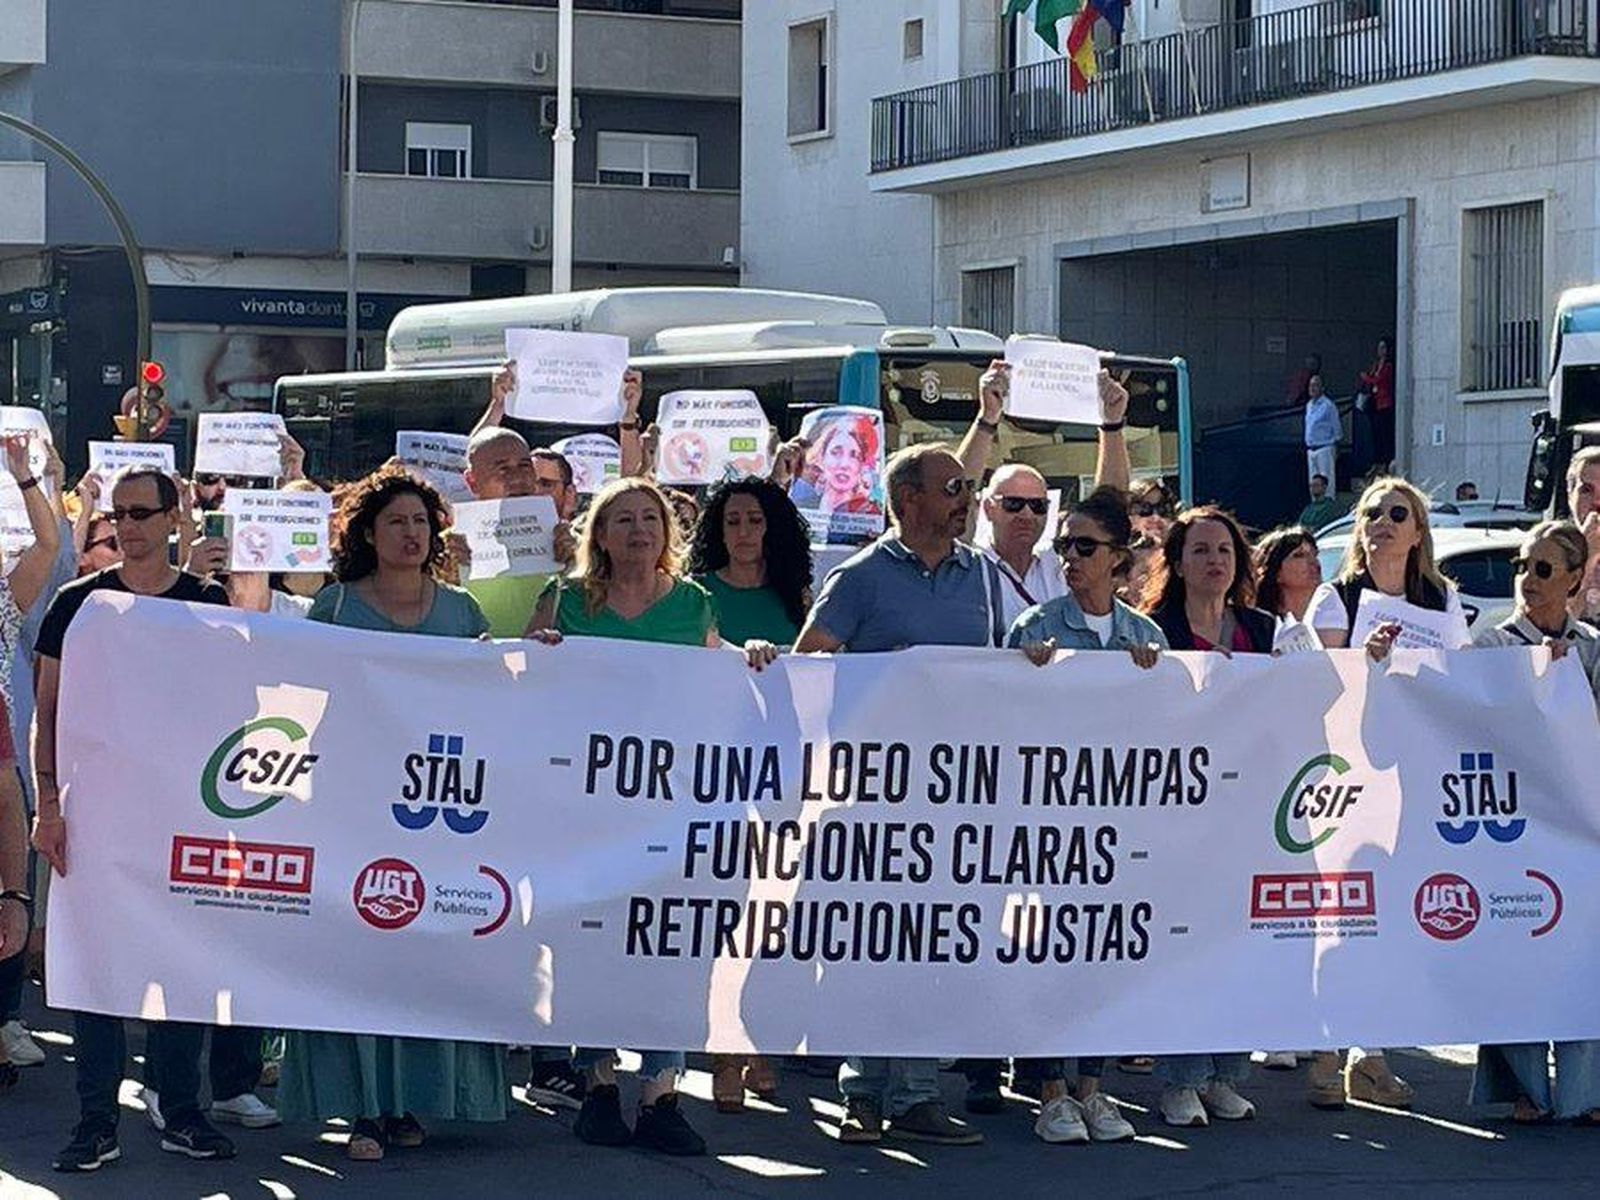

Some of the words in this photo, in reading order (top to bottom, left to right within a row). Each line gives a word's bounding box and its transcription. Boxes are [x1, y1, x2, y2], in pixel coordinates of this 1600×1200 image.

[225, 748, 319, 787] CSIF
[402, 752, 486, 805] STAJ
[585, 733, 675, 801] POR
[692, 743, 783, 804] UNA
[800, 742, 911, 804] LOEO
[927, 743, 1000, 805] SIN
[1018, 746, 1210, 807] TRAMPAS
[1292, 784, 1364, 820] CSIF
[1441, 771, 1518, 817] STAJ
[180, 845, 307, 885] CCOO
[683, 820, 935, 883] FUNCIONES
[952, 823, 1118, 886] CLARAS
[363, 869, 417, 900] UGT
[435, 884, 493, 901] Servicios
[1259, 882, 1368, 911] CCOO
[1421, 883, 1471, 911] UGT
[1488, 892, 1544, 905] Servicios
[625, 896, 982, 965] RETRIBUCIONES
[996, 902, 1153, 965] JUSTAS
